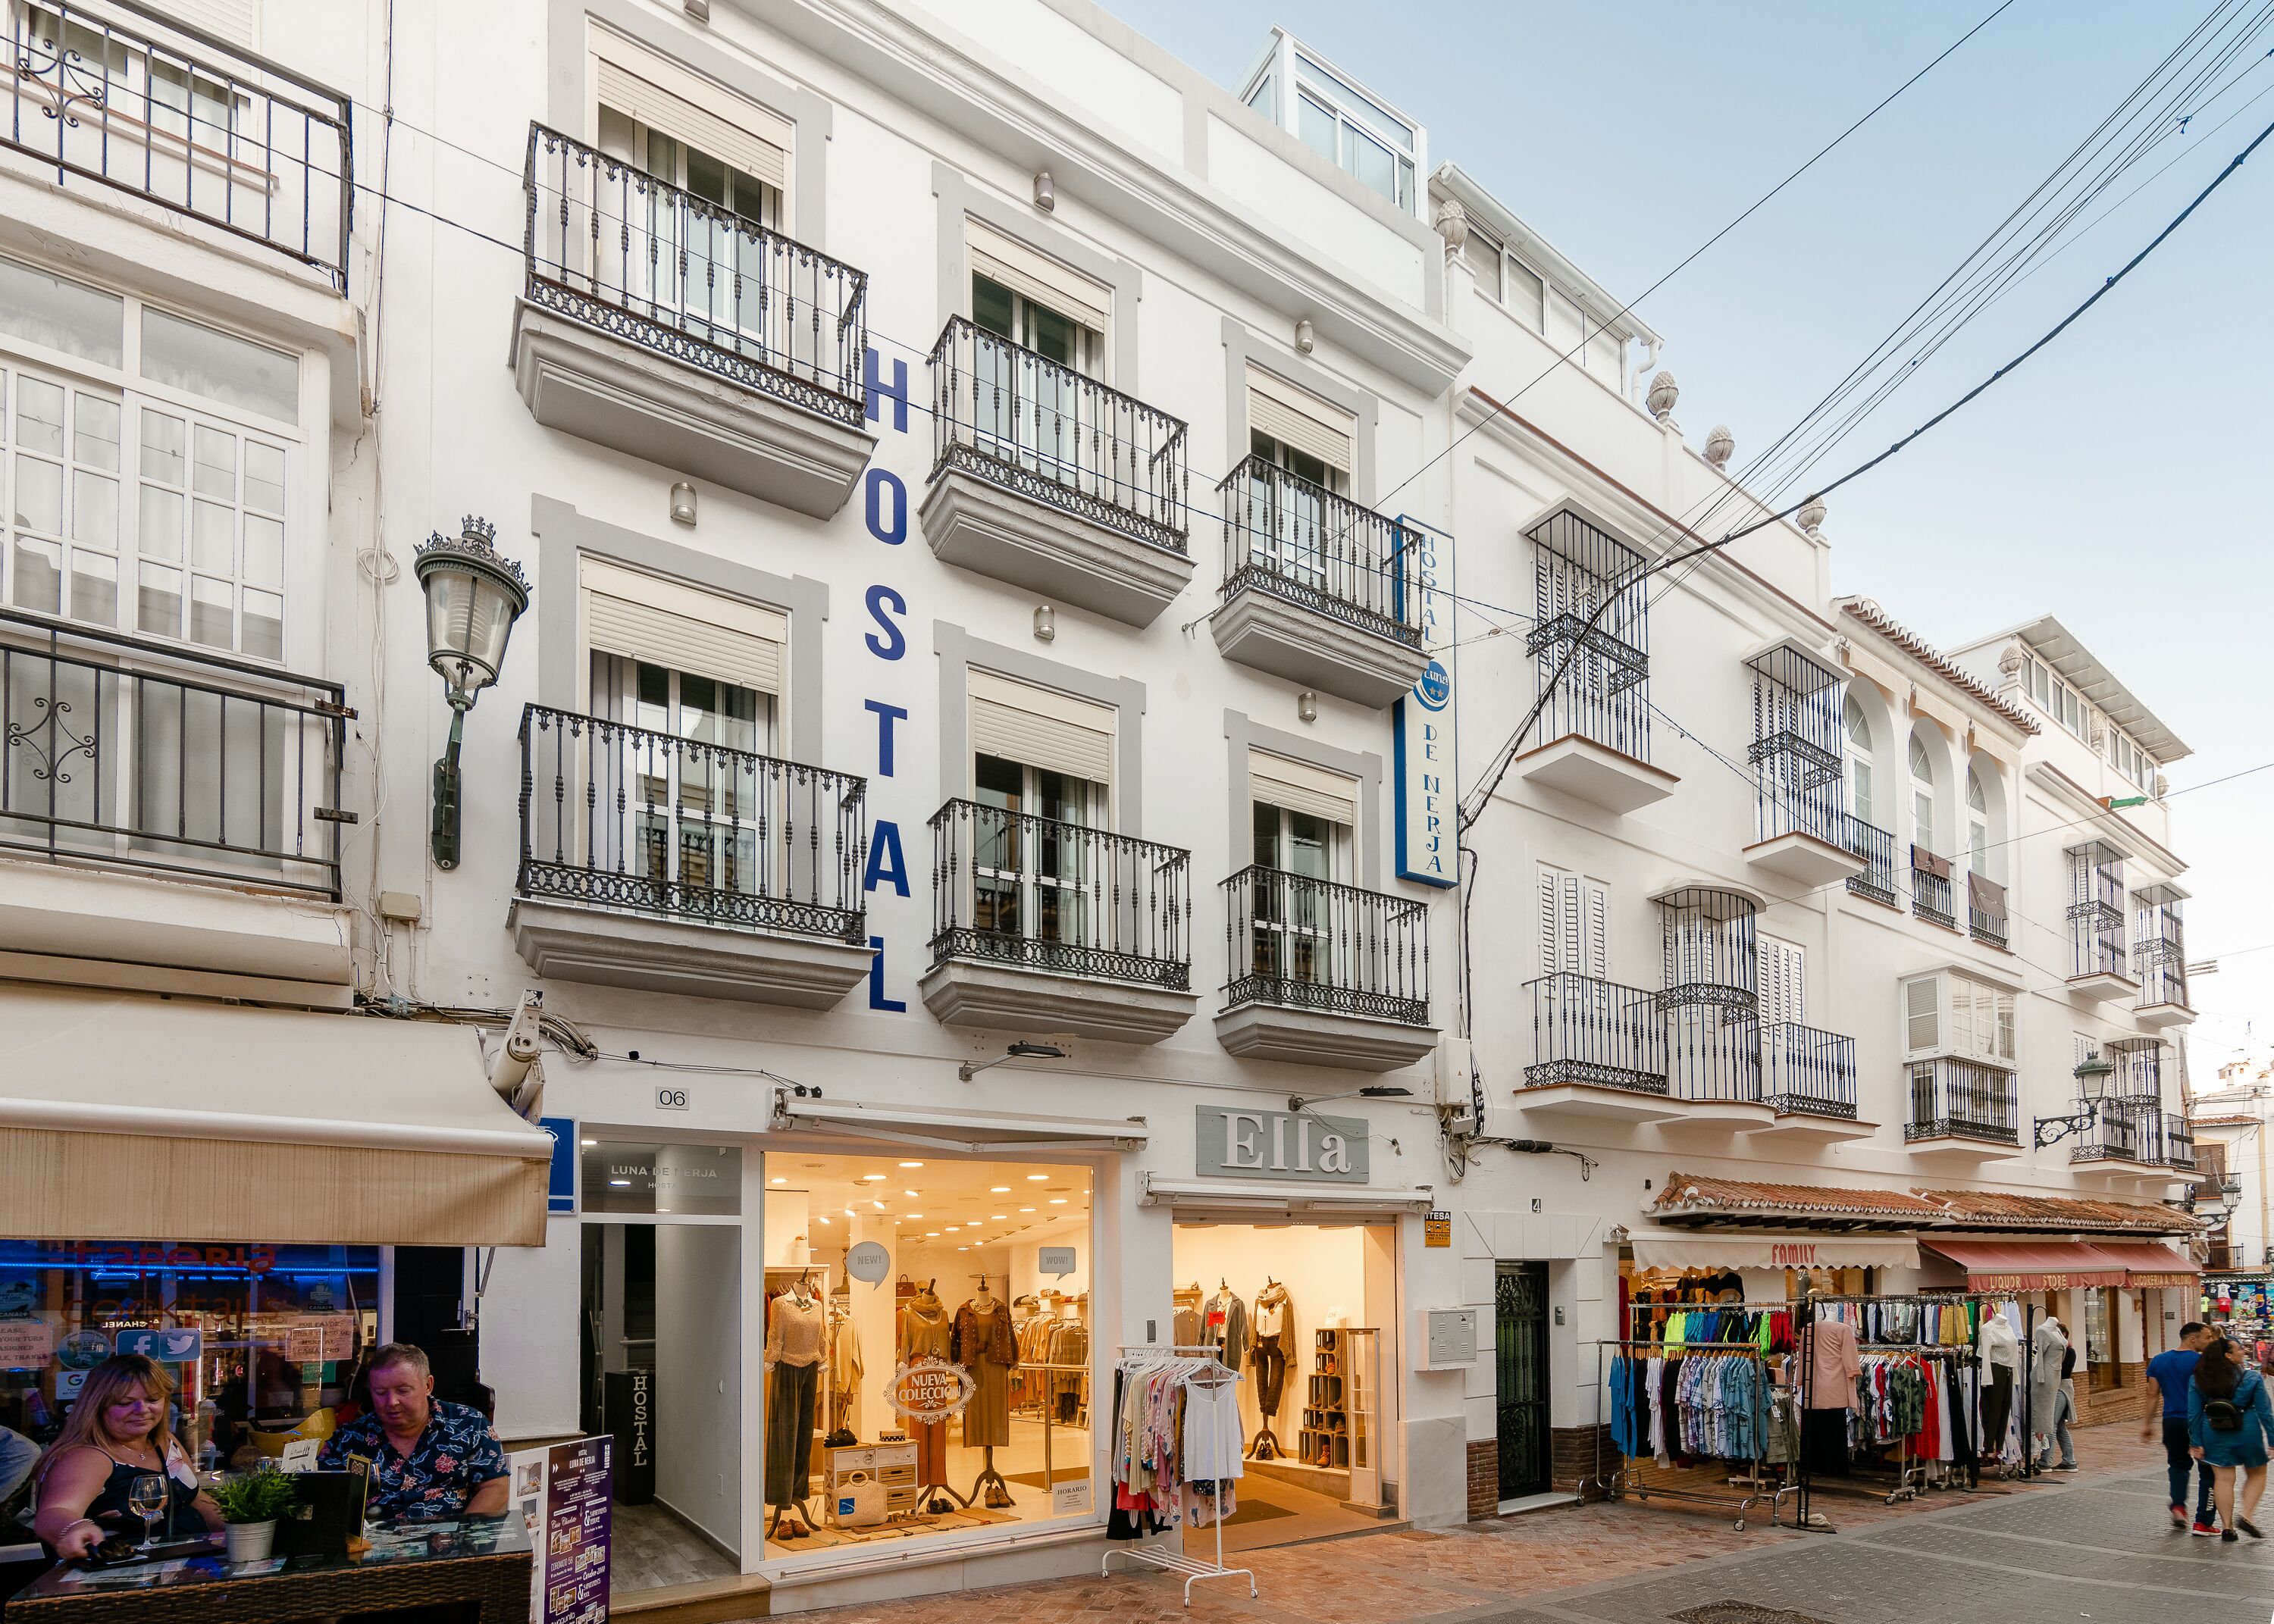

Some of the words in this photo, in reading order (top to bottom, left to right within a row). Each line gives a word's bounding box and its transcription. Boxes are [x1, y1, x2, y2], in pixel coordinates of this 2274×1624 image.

[1420, 533, 1437, 645] HOSTAL
[863, 347, 910, 1014] HOSTAL
[1424, 670, 1449, 686] Luna
[1424, 723, 1438, 762] DE
[1423, 773, 1443, 873] NERJA
[659, 1090, 685, 1106] 06
[1219, 1112, 1352, 1174] Ella
[611, 1165, 648, 1176] LUNA
[653, 1166, 670, 1177] DE
[648, 1181, 683, 1190] HOSTA
[1533, 1199, 1541, 1213] 4
[857, 1254, 882, 1265] NEW!
[1045, 1256, 1068, 1265] WOW!
[1771, 1244, 1816, 1264] FAMILY
[1989, 1275, 2022, 1289] LIQUOR
[2042, 1275, 2067, 1288] STORE
[2133, 1275, 2163, 1287] LICORERIA
[911, 1372, 947, 1388] NUEVA
[898, 1384, 961, 1402] COLECCIÓN
[633, 1375, 648, 1467] HOSTAL
[1057, 1485, 1088, 1496] HORARIO
